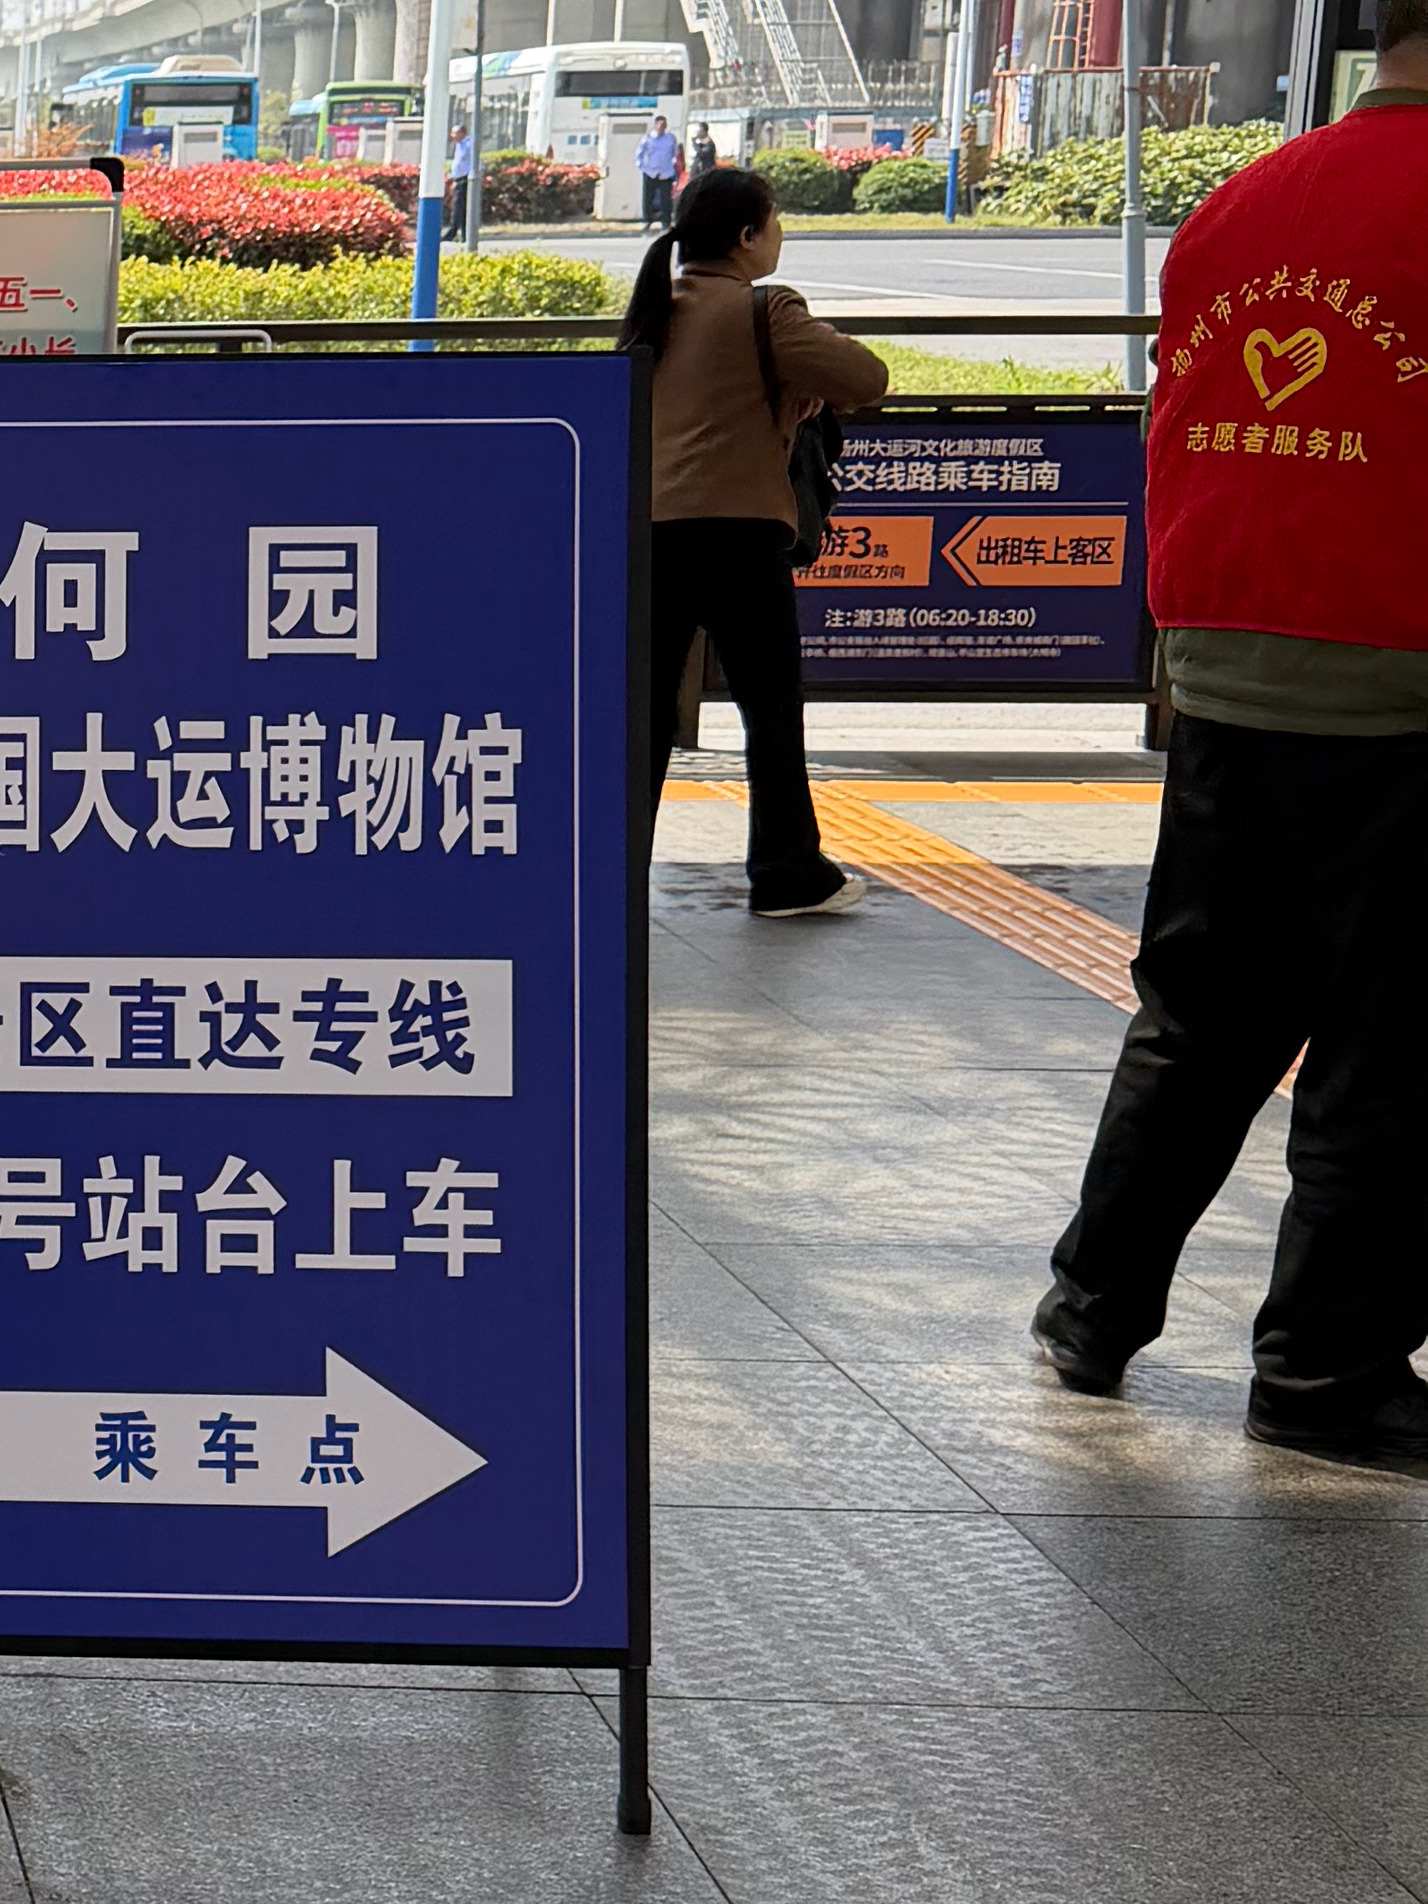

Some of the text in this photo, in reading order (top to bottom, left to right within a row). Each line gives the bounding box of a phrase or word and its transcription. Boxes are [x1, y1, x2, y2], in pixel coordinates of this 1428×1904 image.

[1187, 422, 1368, 463] 志愿者服务队
[977, 537, 1114, 566] 出租车上客区
[94, 1410, 364, 1486] 乘车点
